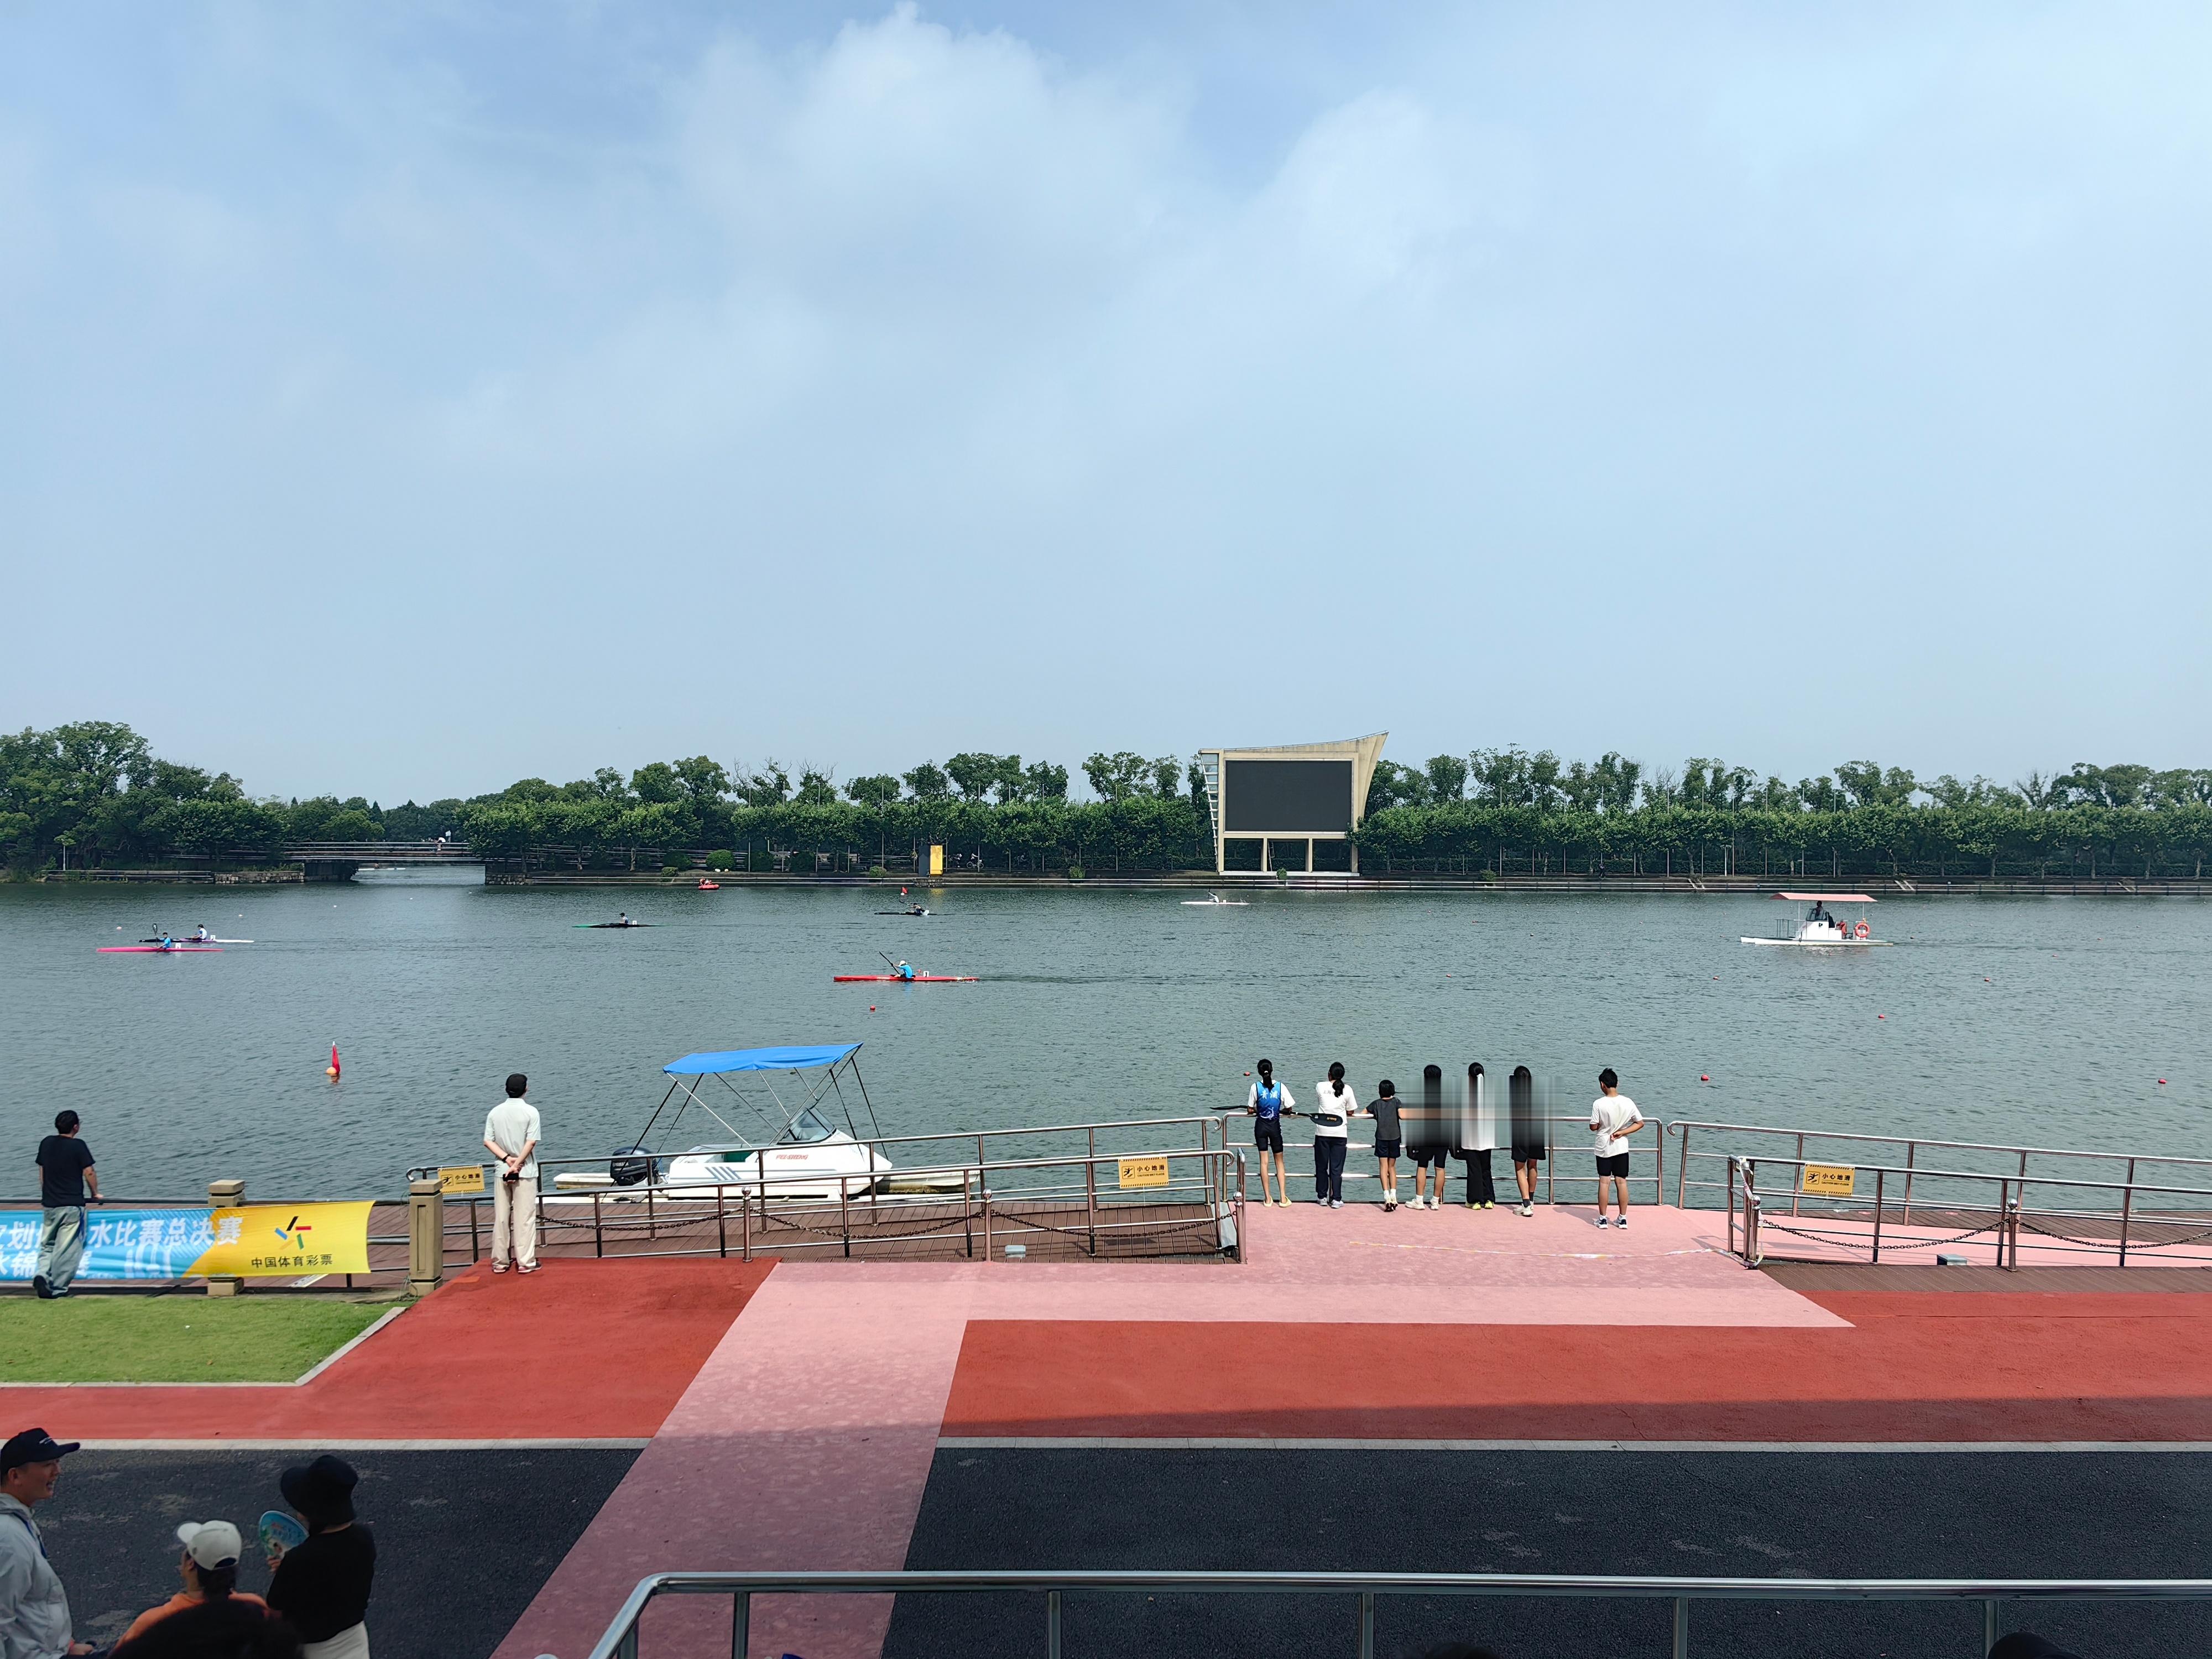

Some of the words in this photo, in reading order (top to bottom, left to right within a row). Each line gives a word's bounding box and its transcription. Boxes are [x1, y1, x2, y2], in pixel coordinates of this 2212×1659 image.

[0, 1216, 243, 1249] 划水比赛总决赛
[251, 1254, 332, 1269] 中国体育彩票
